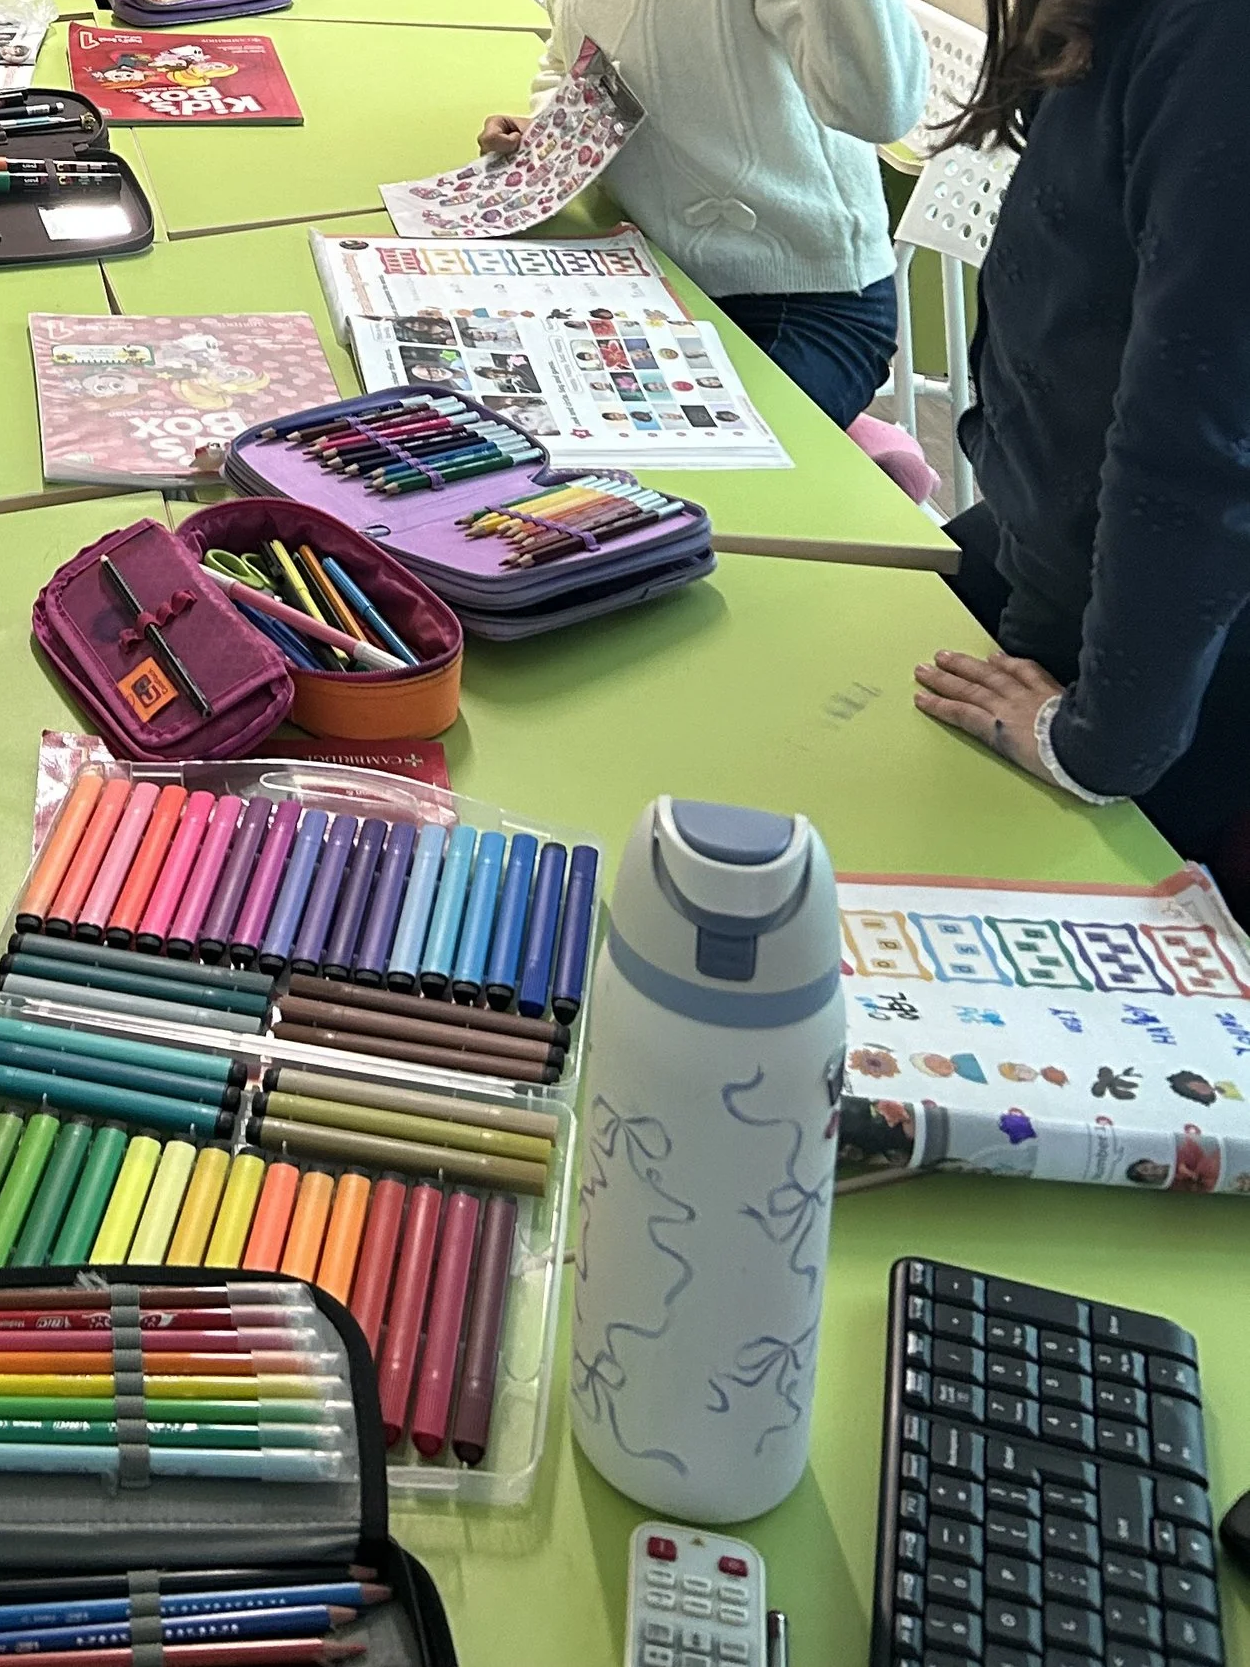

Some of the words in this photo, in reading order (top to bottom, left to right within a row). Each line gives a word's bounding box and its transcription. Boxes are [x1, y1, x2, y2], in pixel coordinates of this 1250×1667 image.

[133, 85, 222, 104] Box
[148, 94, 262, 117] Kid's
[127, 410, 248, 439] Box
